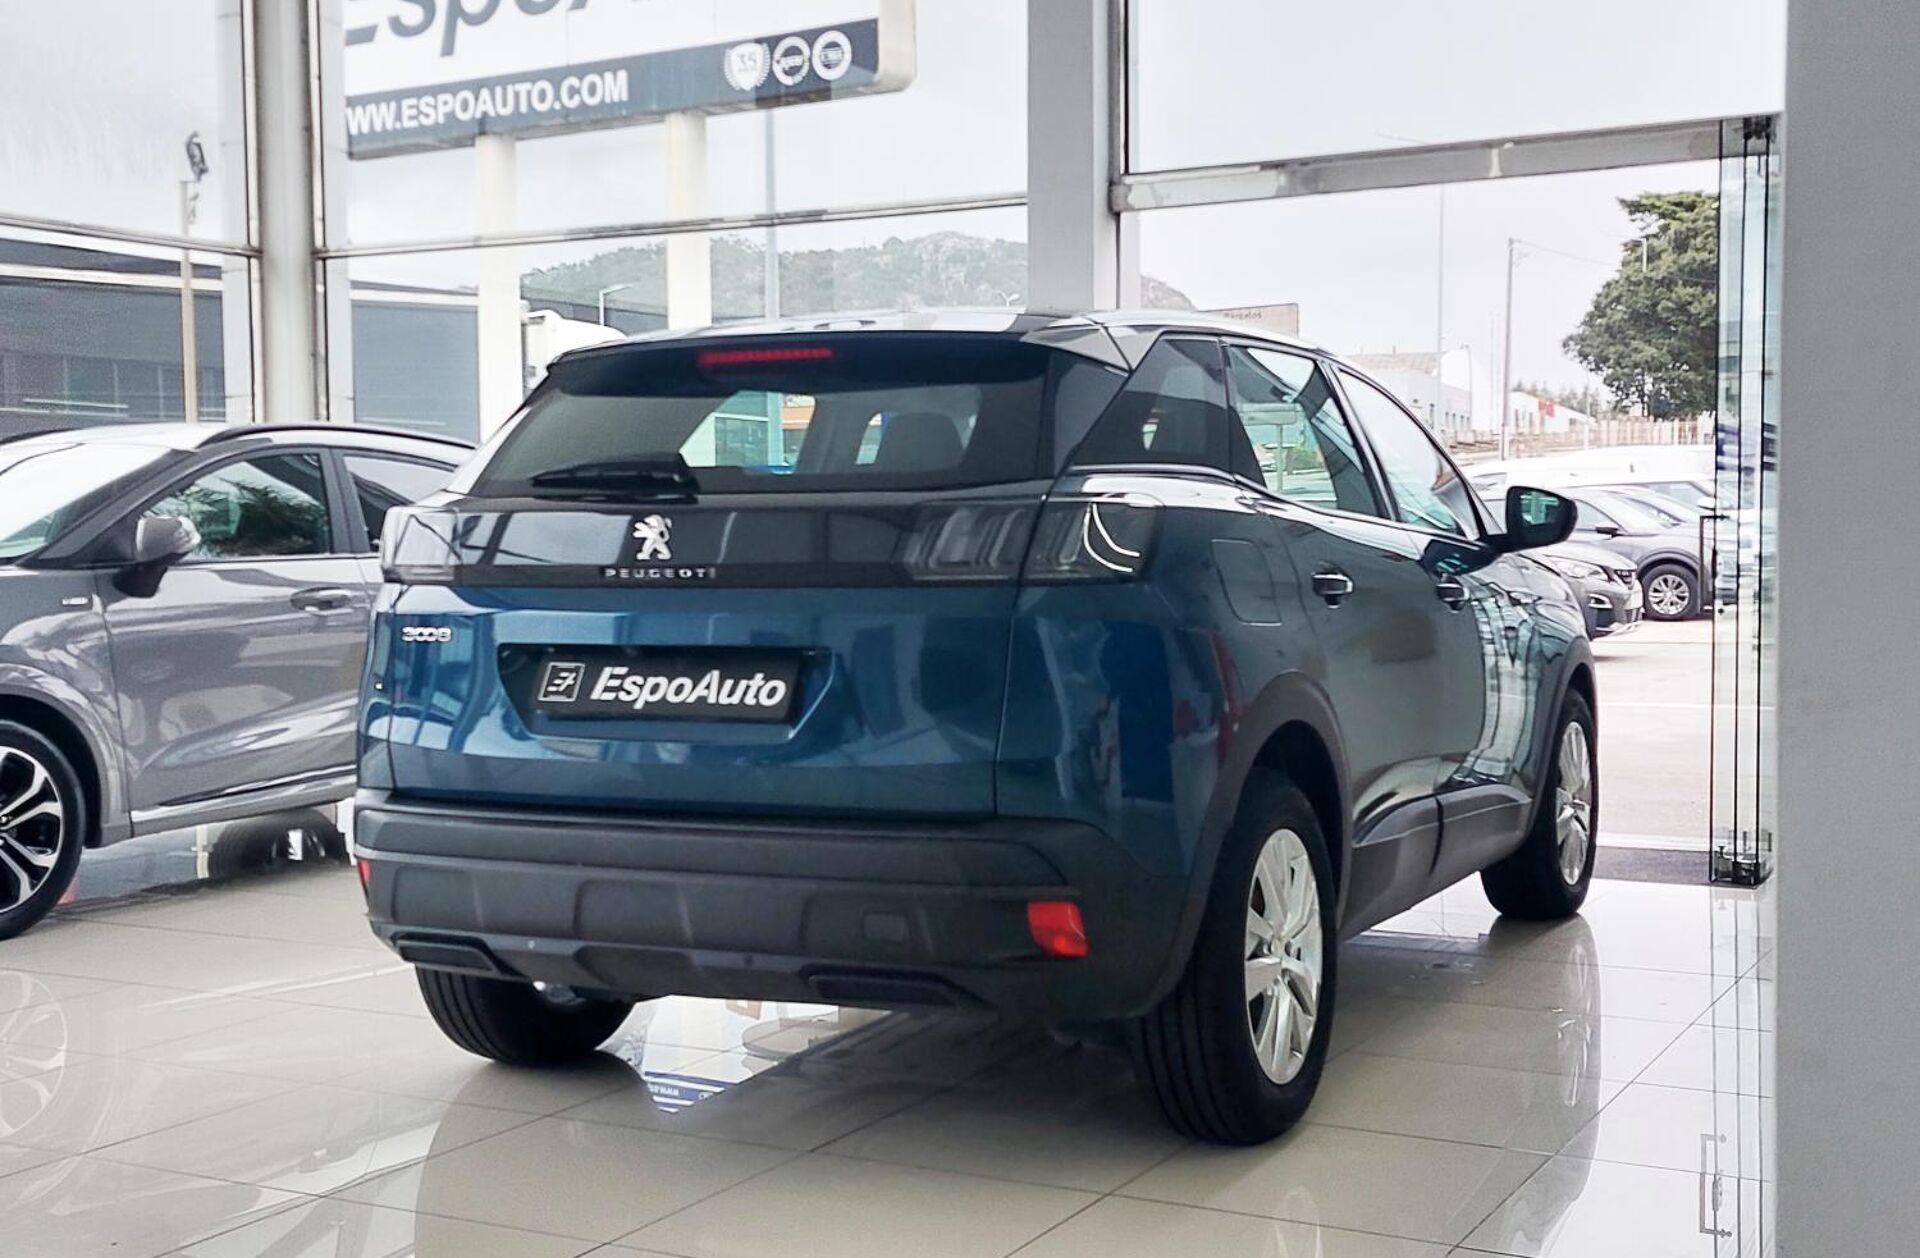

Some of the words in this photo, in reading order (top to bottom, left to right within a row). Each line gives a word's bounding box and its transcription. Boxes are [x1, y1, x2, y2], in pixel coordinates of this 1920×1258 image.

[604, 567, 707, 579] PEUGEOT
[402, 626, 451, 641] 3008
[590, 666, 787, 709] EspoAuto
